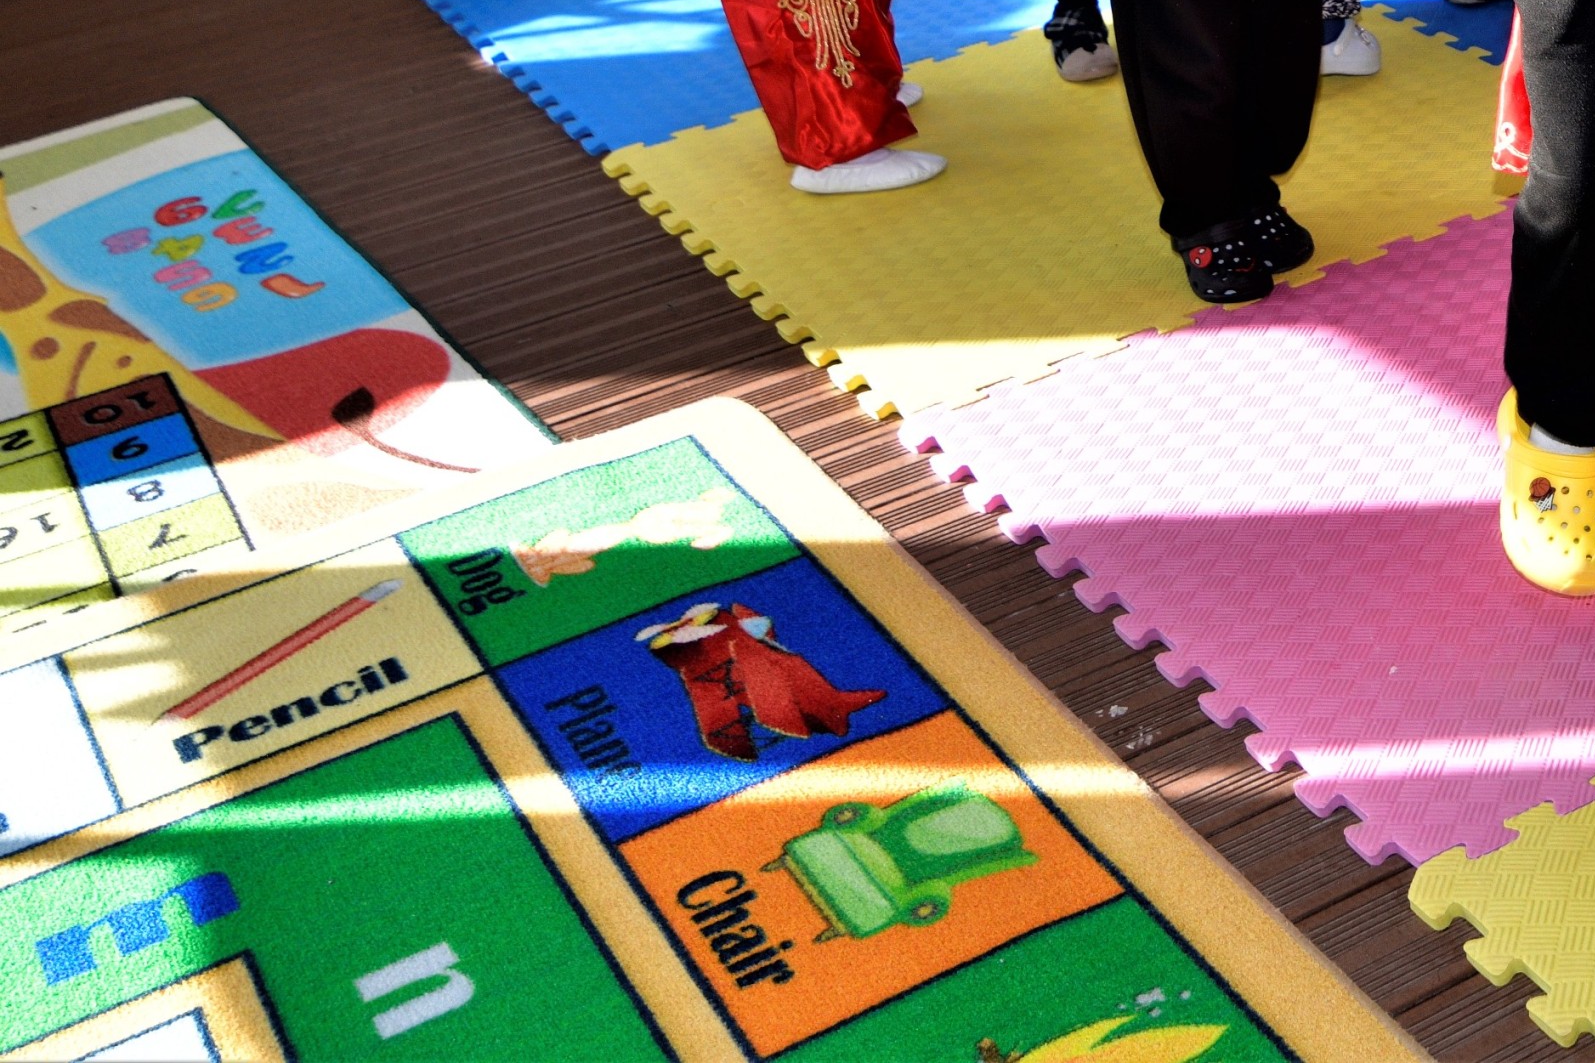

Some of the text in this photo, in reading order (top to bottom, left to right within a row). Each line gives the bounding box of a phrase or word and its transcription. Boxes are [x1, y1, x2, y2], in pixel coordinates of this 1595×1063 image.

[83, 390, 156, 425] 10
[127, 480, 164, 503] 8
[148, 523, 188, 551] 7
[449, 547, 527, 616] Dog
[172, 656, 409, 764] Pencil
[544, 685, 642, 776] Plane
[676, 870, 795, 990] Chair
